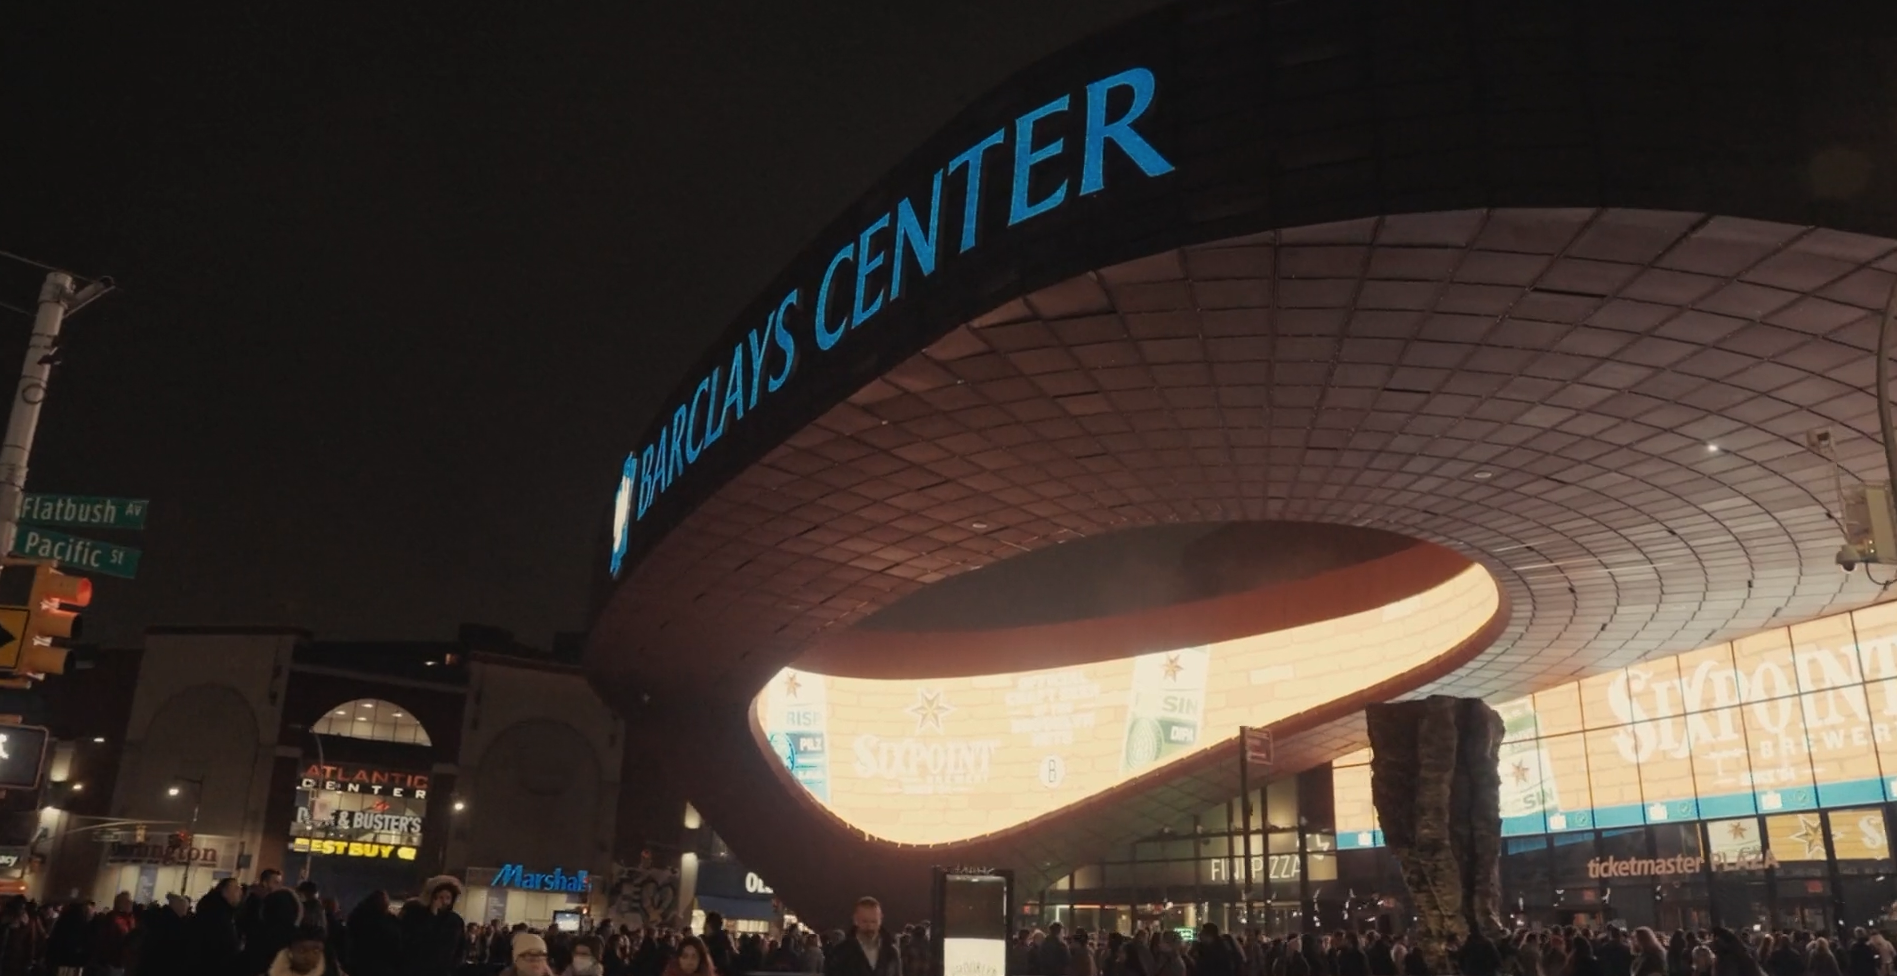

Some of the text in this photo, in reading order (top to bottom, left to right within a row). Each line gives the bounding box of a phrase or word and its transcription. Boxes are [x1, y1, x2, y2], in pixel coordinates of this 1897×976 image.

[636, 67, 1175, 521] BARCLAYS CENTER
[21, 497, 142, 523] Flatbush Av
[25, 531, 125, 568] Pacific St
[1608, 633, 1897, 763] SIXPOINT
[1760, 722, 1897, 759] BREWER
[302, 779, 427, 799] CENTER
[303, 764, 429, 789] ATLANTIC
[353, 812, 422, 833] BUSTER'S
[348, 842, 395, 859] BUY
[1588, 854, 1705, 878] ticketmaster
[1709, 849, 1781, 873] PLAZA
[1252, 855, 1300, 879] PZZA
